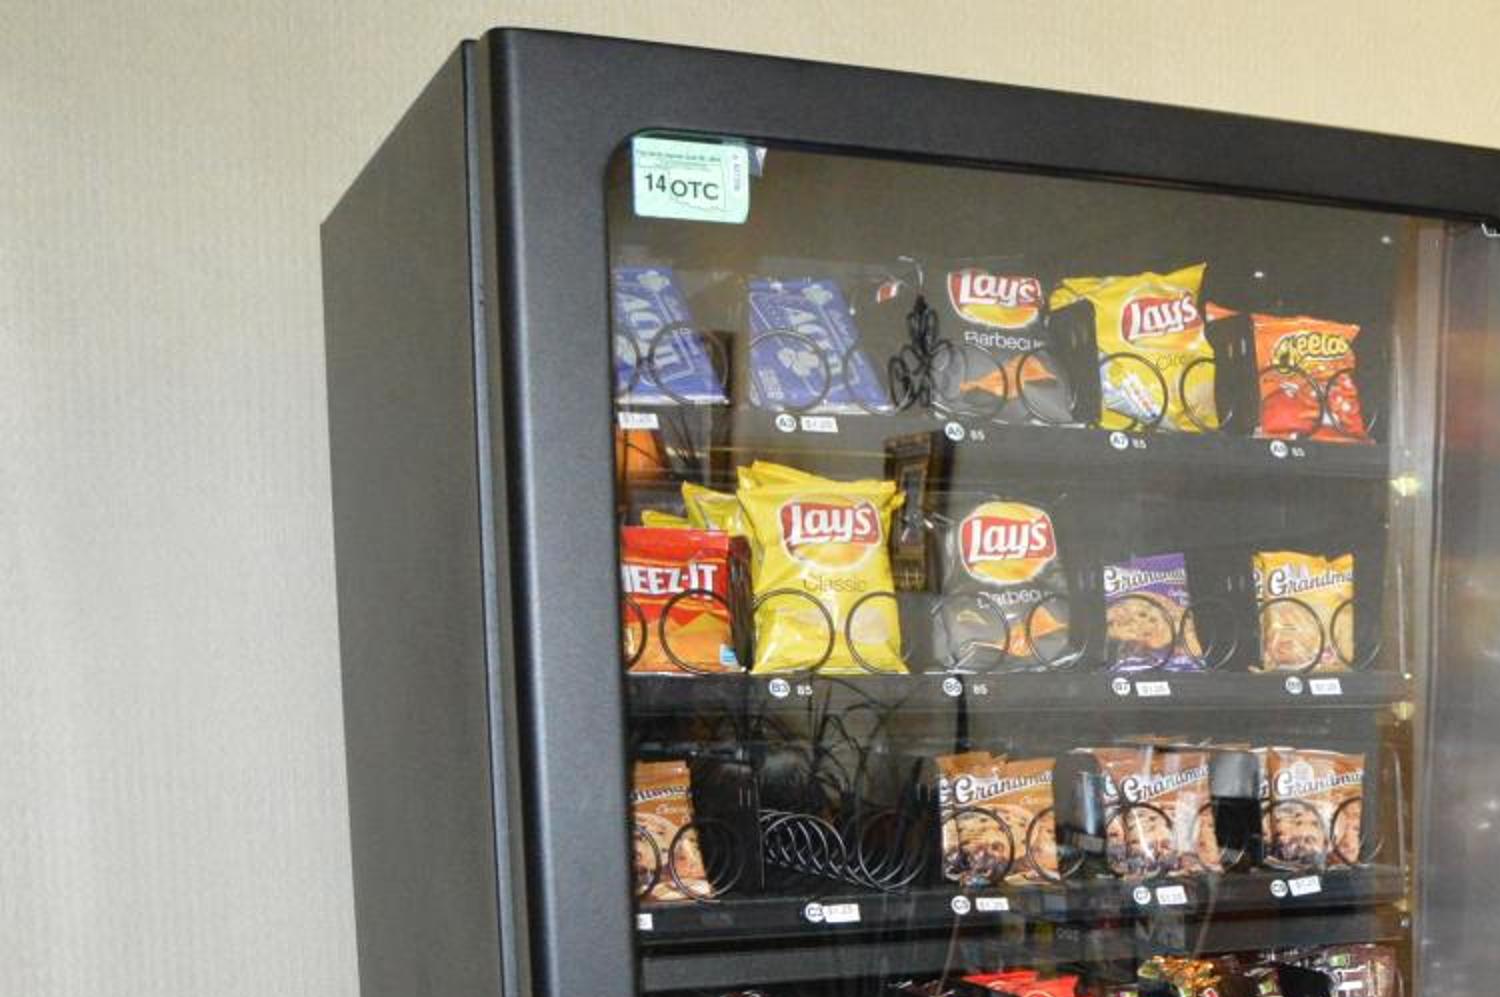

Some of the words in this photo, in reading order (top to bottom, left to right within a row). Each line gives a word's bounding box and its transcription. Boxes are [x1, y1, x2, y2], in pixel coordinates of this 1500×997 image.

[645, 173, 666, 193] 14
[671, 180, 719, 201] OTC
[959, 269, 1036, 306] Lay's
[1128, 291, 1199, 341] Lay's
[789, 500, 872, 545] Lay's
[969, 517, 1048, 563] Lay's
[622, 561, 719, 595] HEEZ-IT
